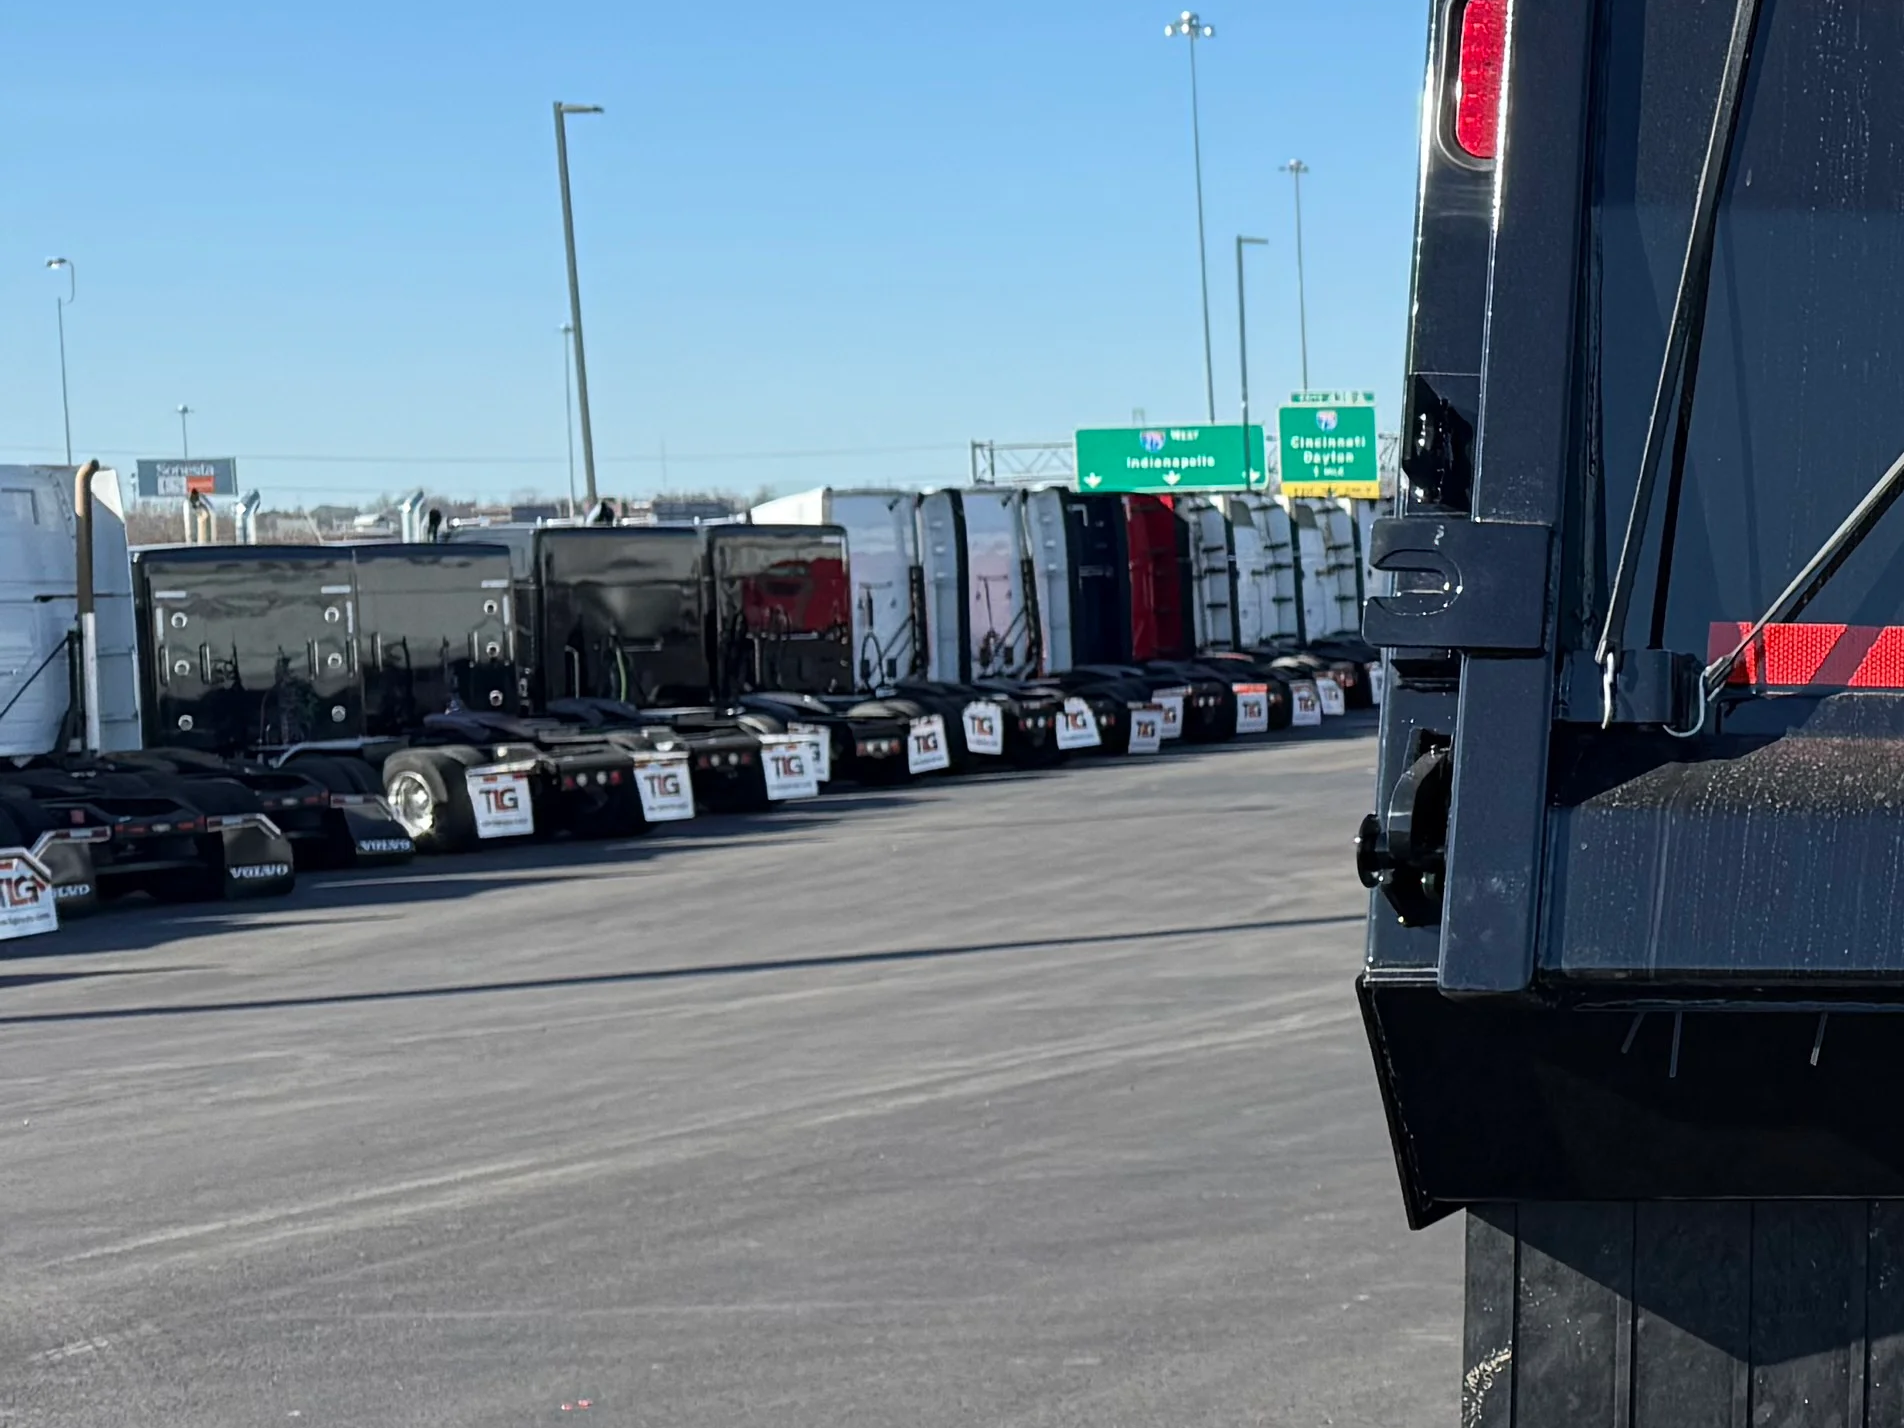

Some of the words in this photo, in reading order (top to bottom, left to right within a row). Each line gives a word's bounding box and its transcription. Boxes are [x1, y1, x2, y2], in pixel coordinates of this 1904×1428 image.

[1290, 435, 1366, 449] Cincinnati
[1126, 455, 1216, 470] Indianapolis
[1303, 450, 1355, 466] Dayton
[969, 714, 994, 736] TLG
[914, 732, 939, 755] TLG
[770, 755, 804, 778] TLG
[643, 774, 681, 799] TLG
[479, 788, 519, 814] TLG
[360, 839, 411, 851] VOLVO
[229, 864, 289, 878] VOLVO
